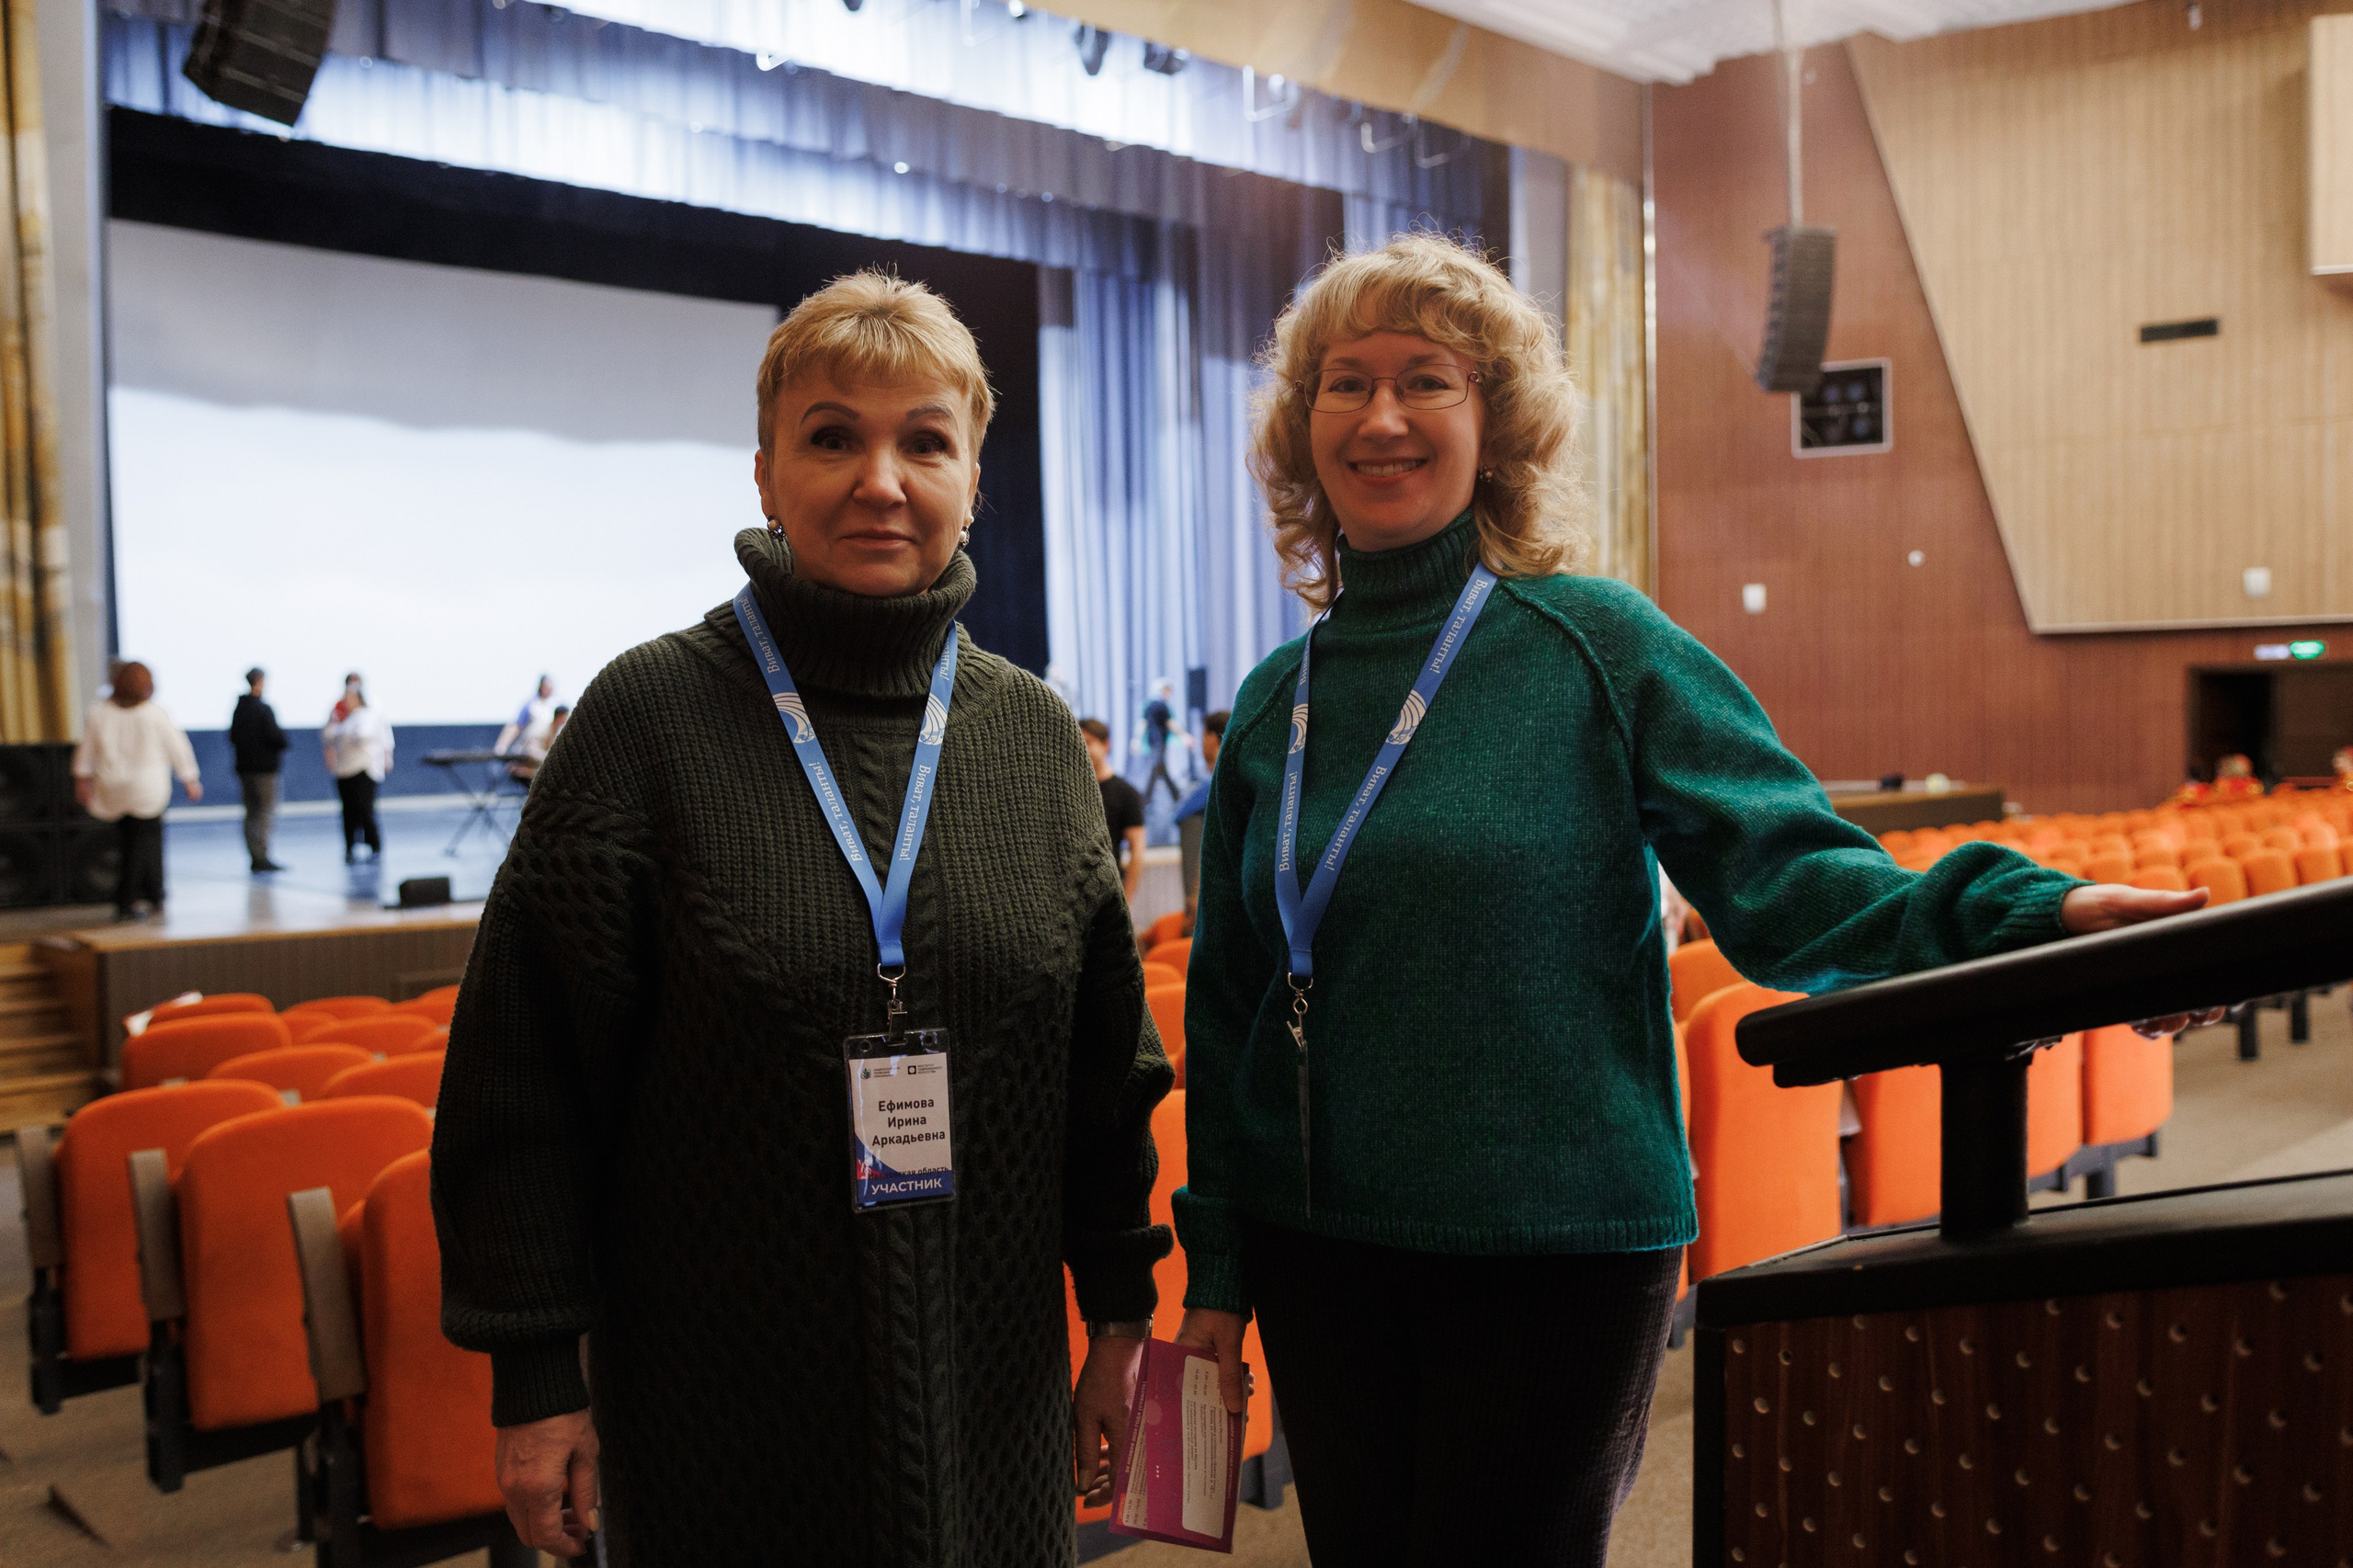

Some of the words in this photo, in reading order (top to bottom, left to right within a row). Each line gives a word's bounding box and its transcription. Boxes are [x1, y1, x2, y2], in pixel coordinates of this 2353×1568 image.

[738, 596, 764, 637] таланты!
[1459, 579, 1489, 613] Виват,
[758, 636, 780, 674] Виват,
[1429, 616, 1466, 674] таланты!
[808, 762, 844, 820] таланты!
[910, 765, 931, 803] Виват,
[1284, 771, 1298, 828] таланты!
[1356, 766, 1387, 807] Виват,
[839, 820, 863, 861] Виват,
[899, 805, 919, 860] таланты!
[1279, 828, 1292, 872] Виват,
[1324, 809, 1360, 871] таланты!
[878, 1099, 935, 1113] Ефимова
[887, 1116, 926, 1130] Ирина
[871, 1131, 946, 1148] Аркадьевна
[871, 1178, 942, 1195] УЧАСТНИК
[917, 1166, 949, 1175] область
